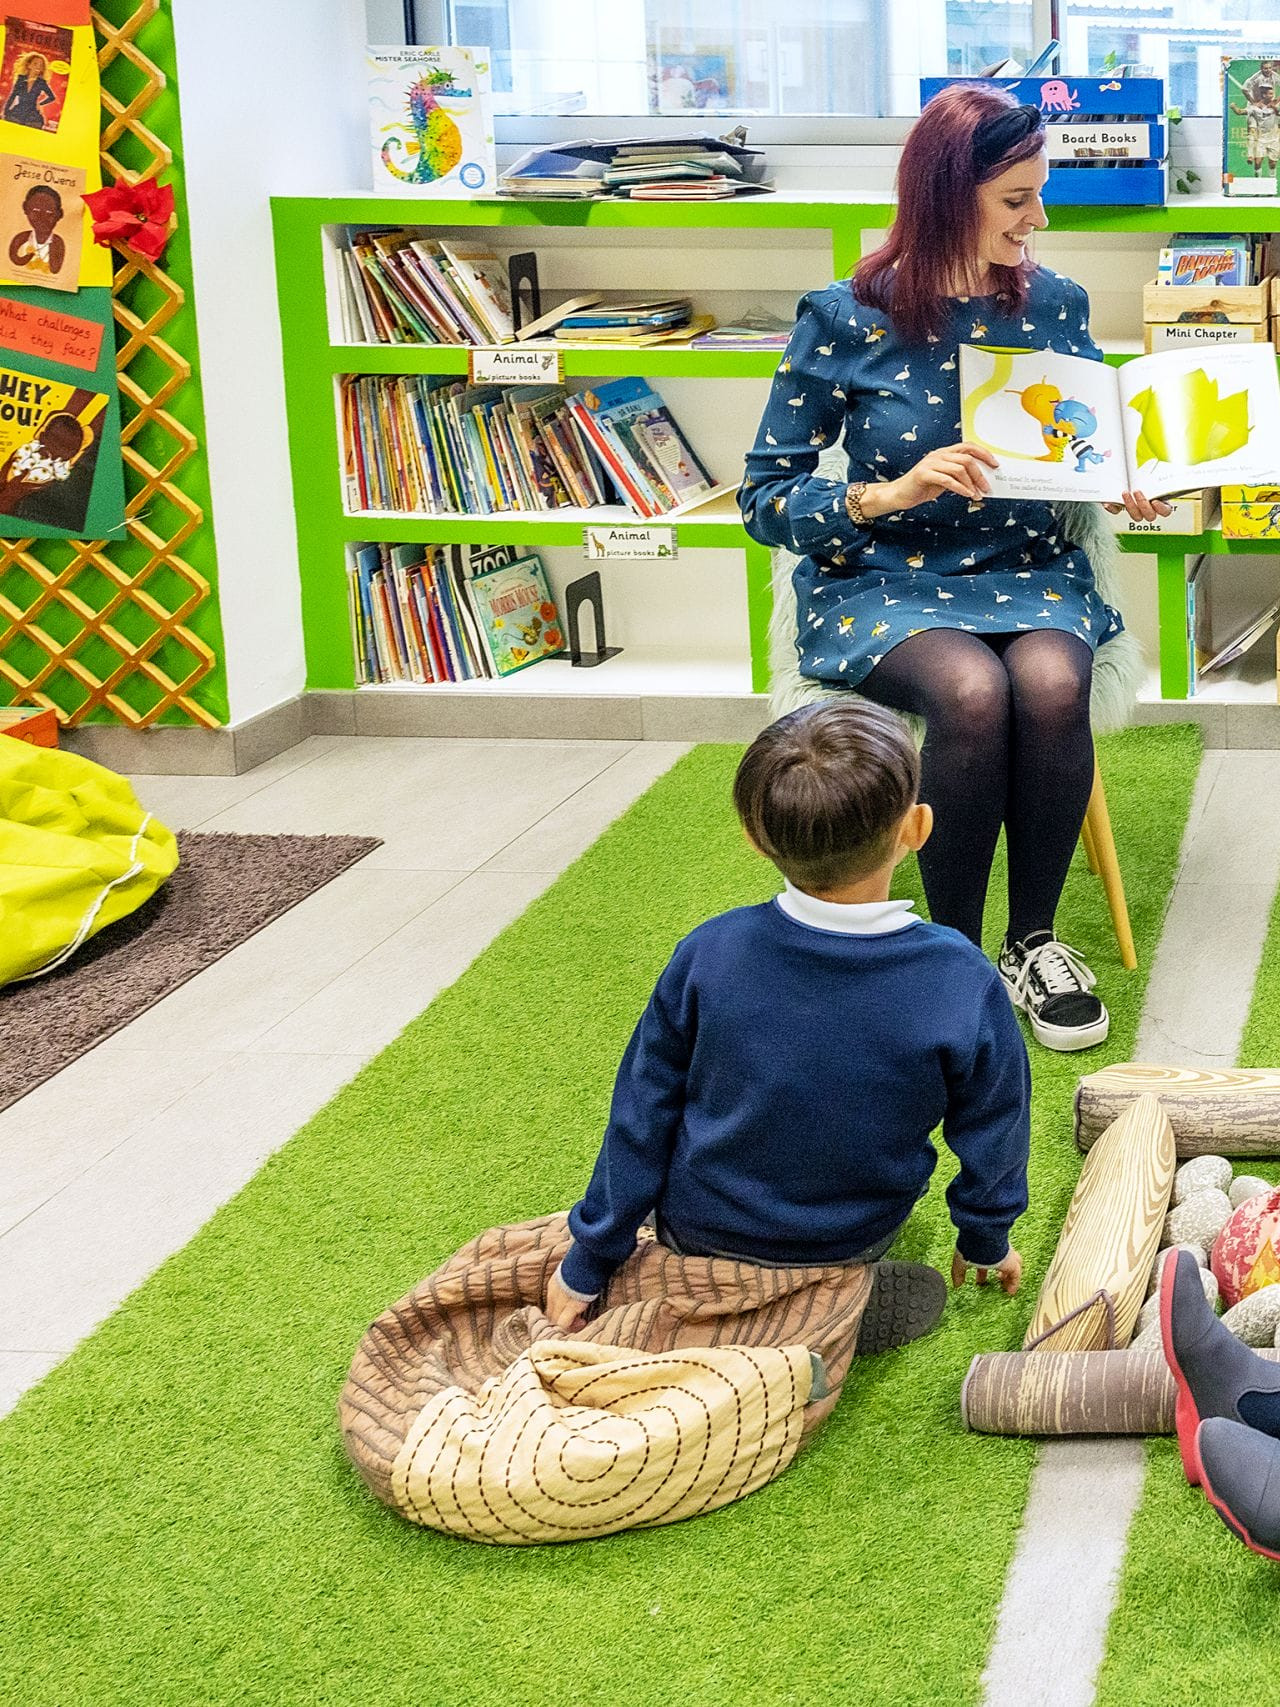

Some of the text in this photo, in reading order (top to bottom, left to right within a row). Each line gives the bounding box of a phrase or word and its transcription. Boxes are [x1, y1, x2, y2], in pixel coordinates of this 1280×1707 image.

[1062, 133, 1137, 143] Board Books
[14, 164, 42, 180] Jesse
[44, 170, 77, 187] Owens
[0, 302, 91, 342] What challenges
[1166, 328, 1237, 341] Mini Chapter
[31, 335, 53, 355] they
[62, 342, 97, 361] face?
[493, 353, 539, 364] Animal
[0, 374, 52, 405] HEY
[0, 400, 43, 427] OU!
[1129, 522, 1162, 532] Books
[609, 530, 651, 541] Animal
[606, 550, 631, 558] picture
